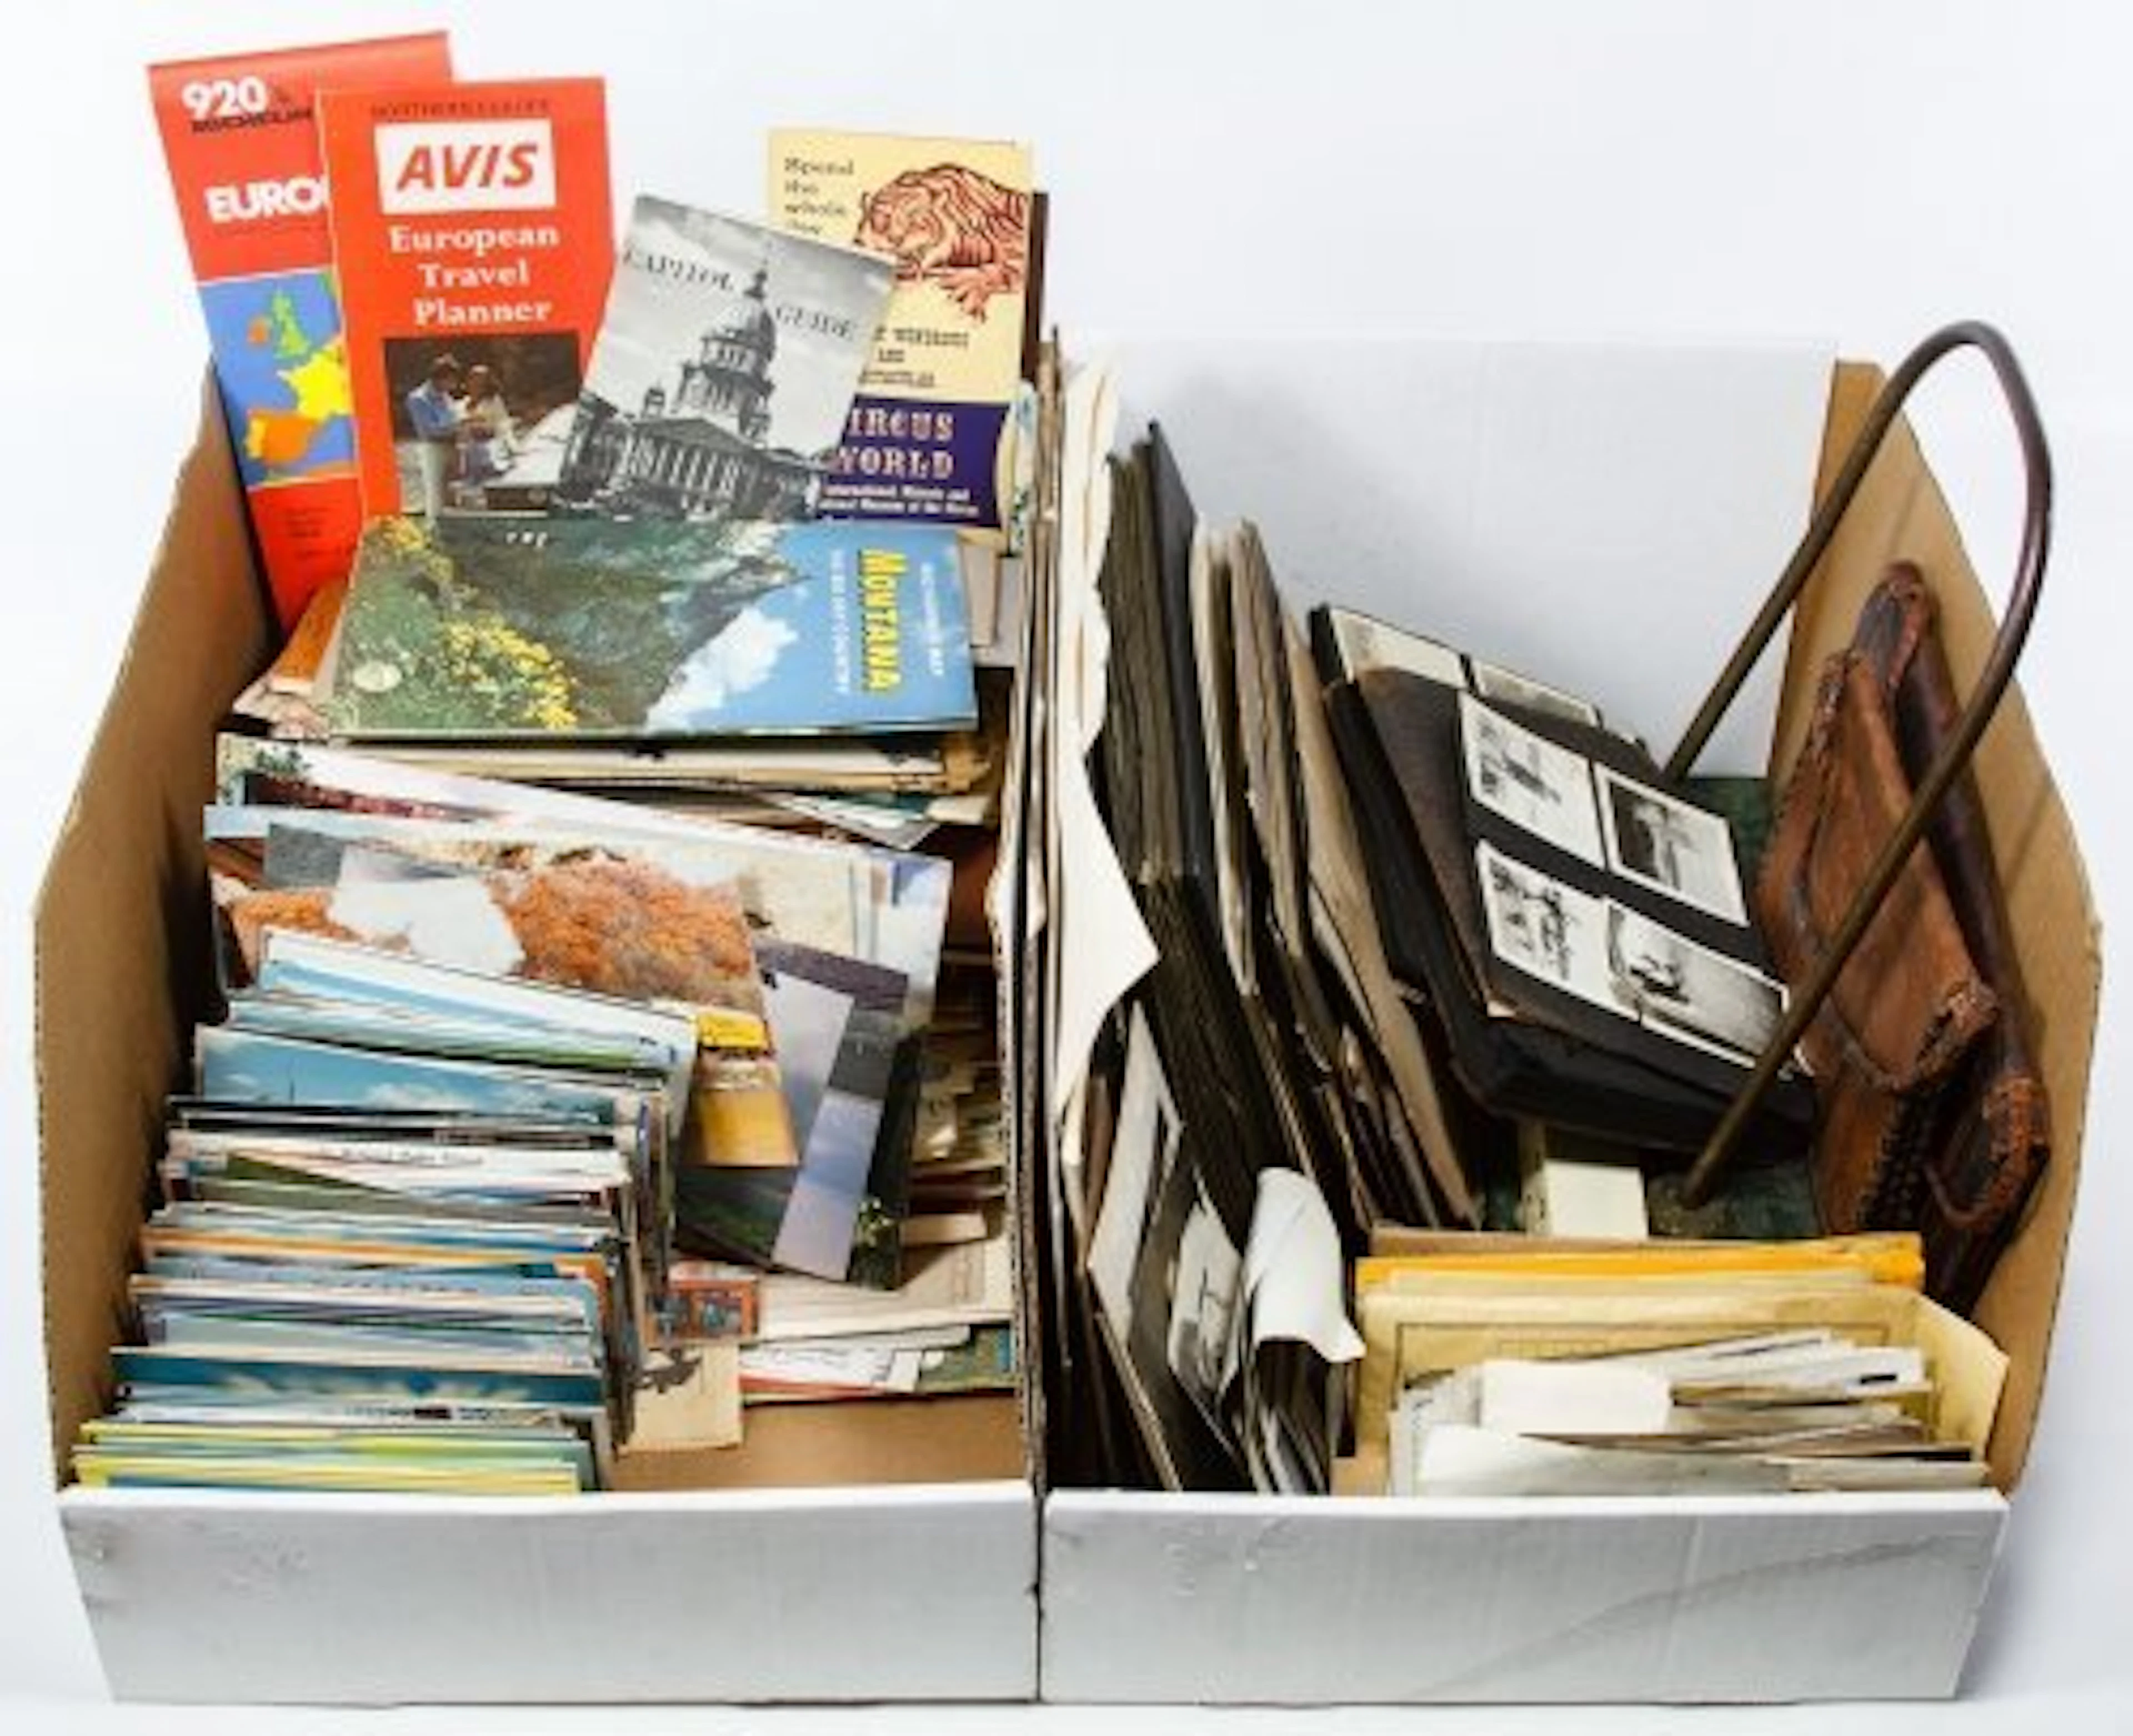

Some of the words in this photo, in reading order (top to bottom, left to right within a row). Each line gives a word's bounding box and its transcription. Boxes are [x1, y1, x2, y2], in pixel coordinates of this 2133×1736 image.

[182, 76, 266, 122] 920
[397, 143, 538, 189] AVIS
[204, 177, 329, 223] EURO
[389, 224, 559, 258] European
[418, 258, 530, 288] Travel
[413, 297, 553, 325] Planner
[847, 408, 954, 441] IRCUS
[859, 548, 909, 691] MONTANA
